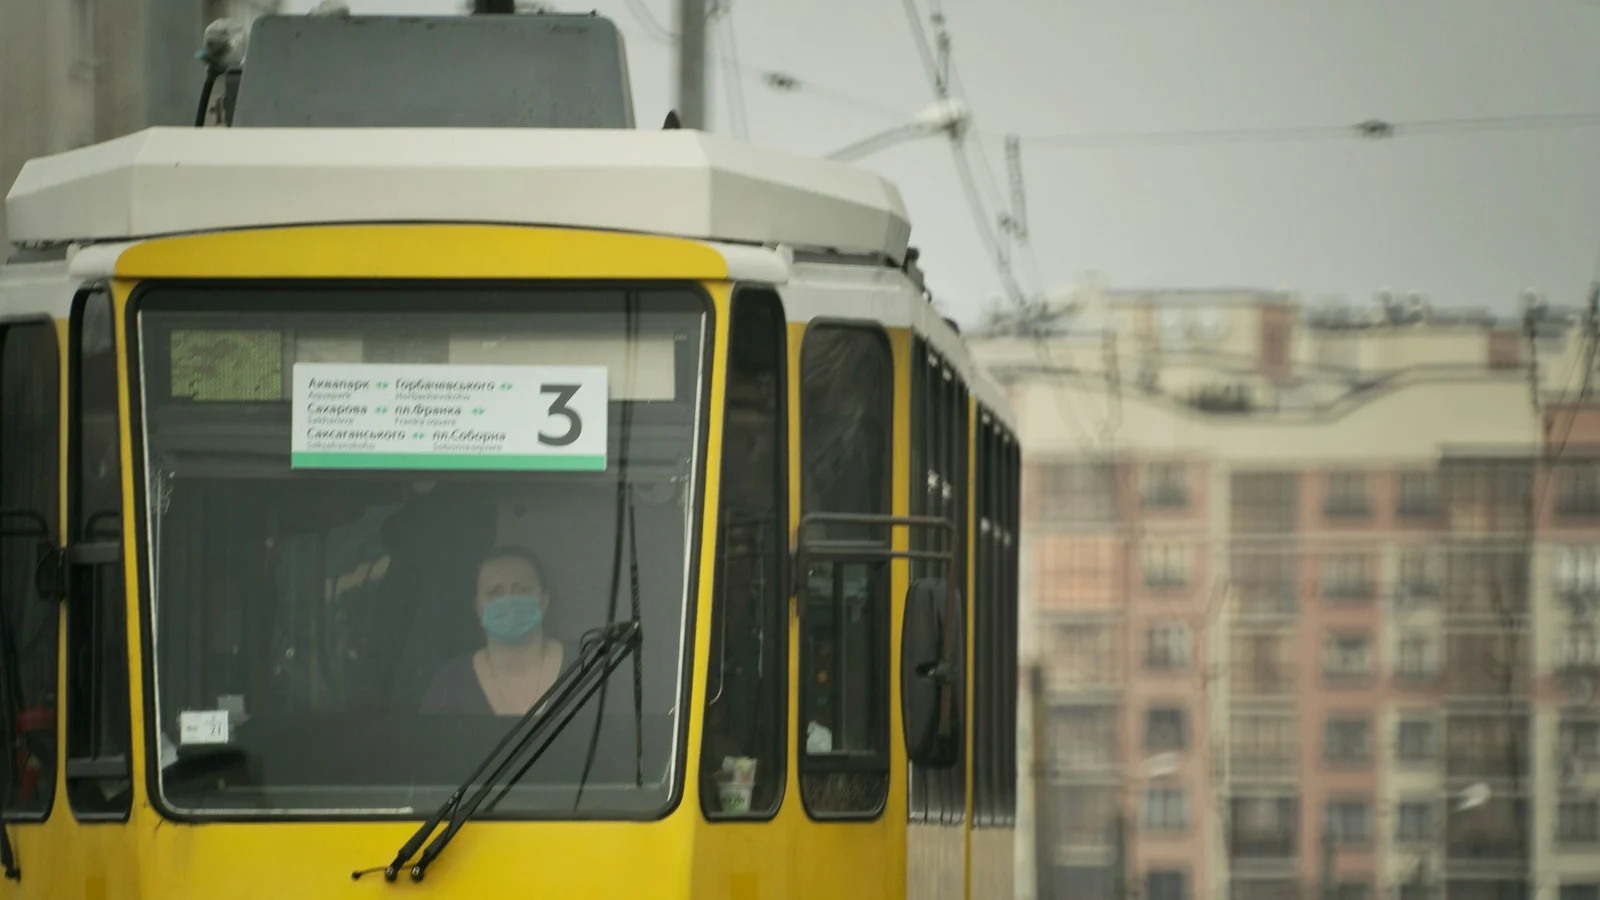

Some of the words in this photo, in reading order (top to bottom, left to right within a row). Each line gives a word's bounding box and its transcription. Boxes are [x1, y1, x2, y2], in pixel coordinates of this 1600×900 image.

[308, 377, 370, 391] Аквапарк
[307, 402, 367, 416] Сахарова
[537, 383, 583, 447] 3
[307, 427, 405, 440] Саксаганського
